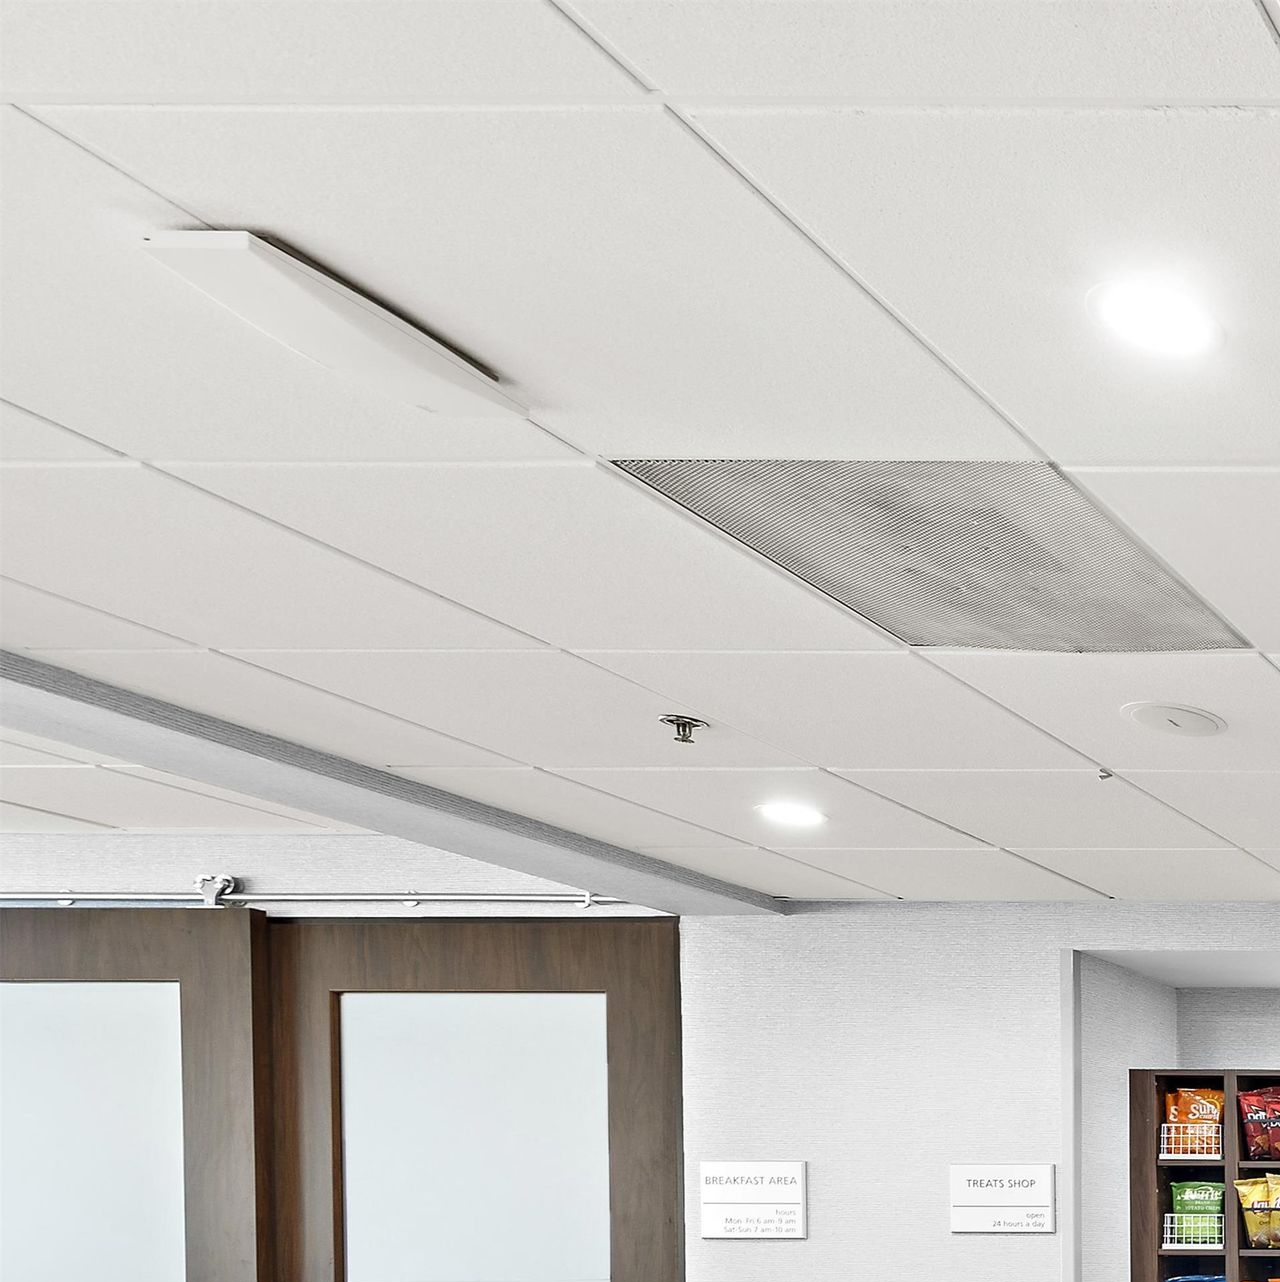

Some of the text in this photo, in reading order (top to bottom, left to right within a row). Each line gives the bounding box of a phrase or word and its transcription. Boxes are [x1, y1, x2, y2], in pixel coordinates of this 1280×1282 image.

[705, 1176, 798, 1186] BREAKFAST AREA
[966, 1179, 1036, 1188] TREATS SHOP
[1032, 1220, 1046, 1228] day
